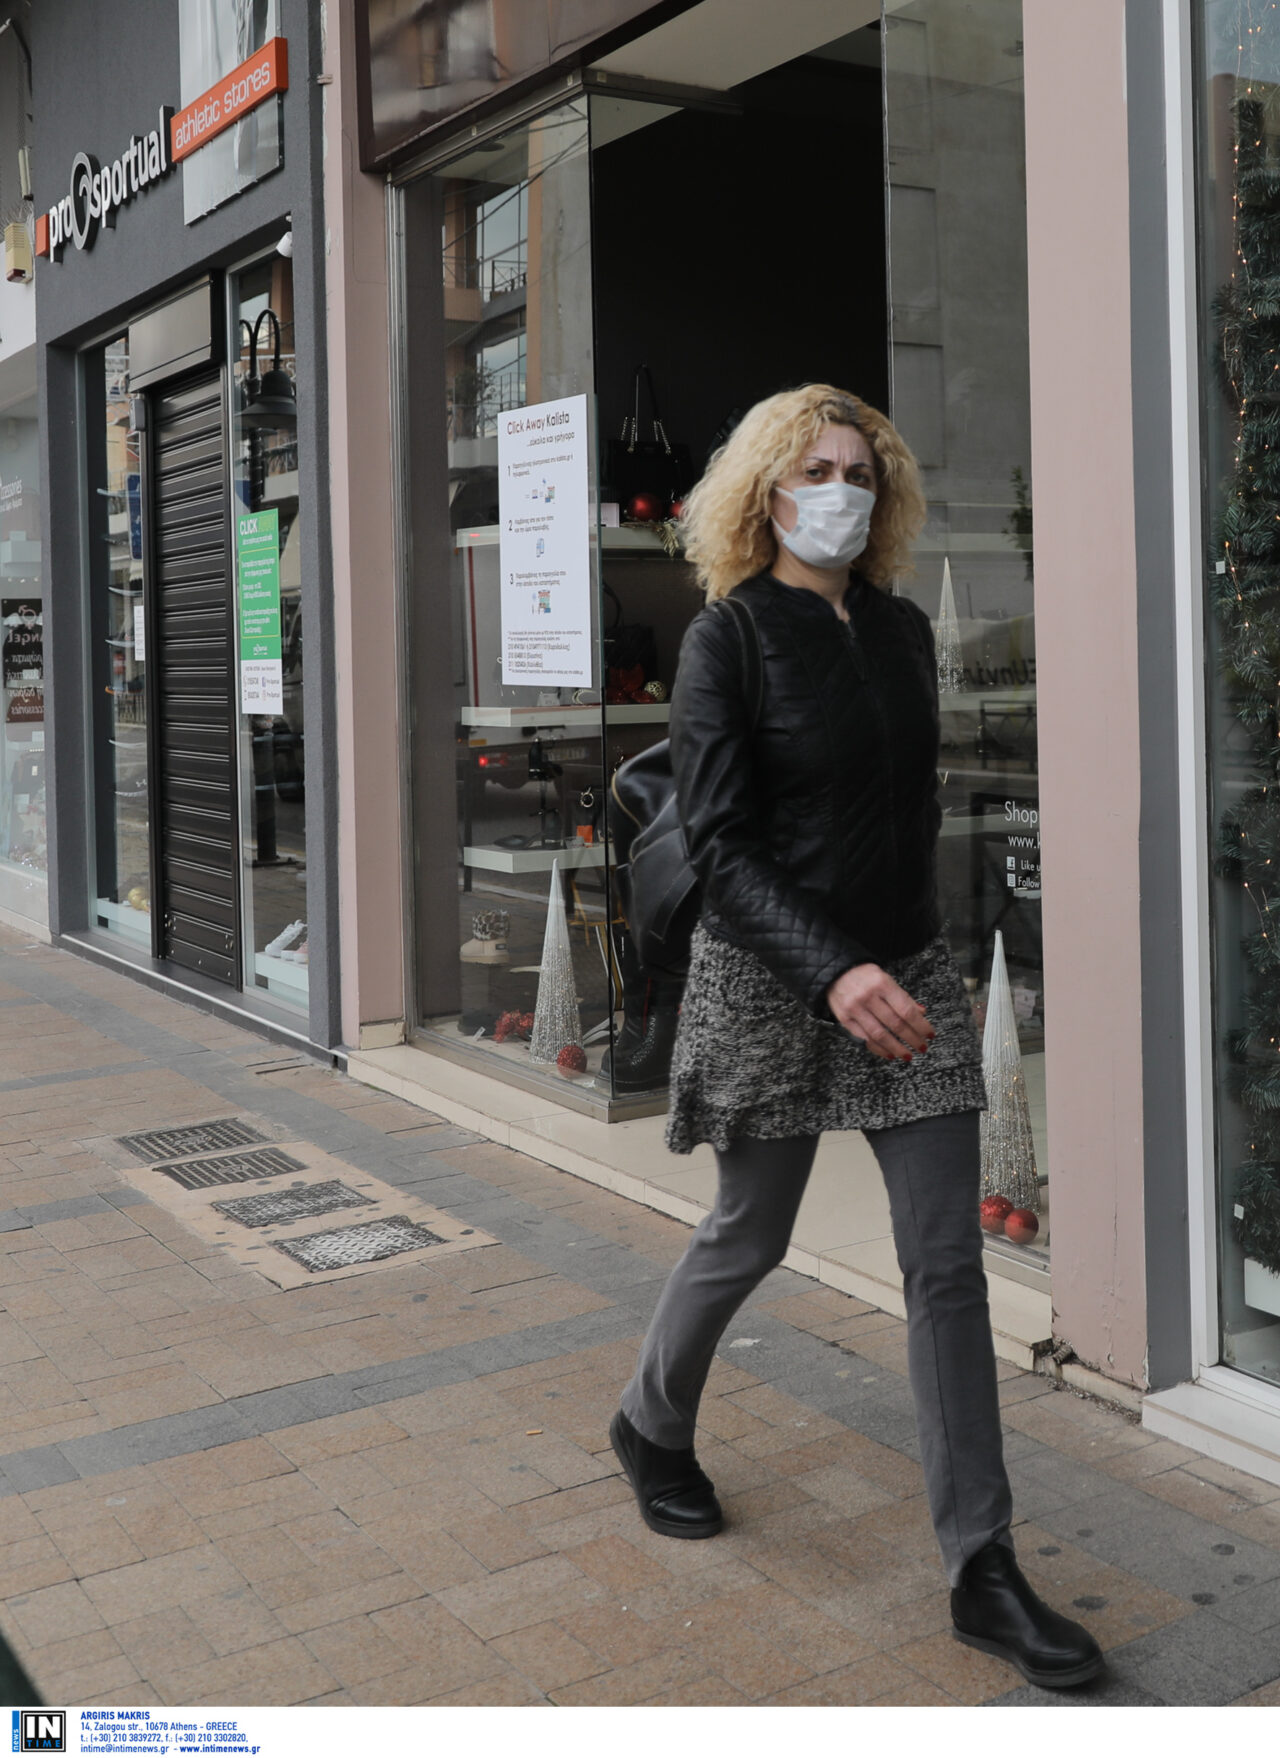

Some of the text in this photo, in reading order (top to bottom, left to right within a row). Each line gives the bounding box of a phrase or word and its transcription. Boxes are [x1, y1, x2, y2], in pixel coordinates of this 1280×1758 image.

[175, 61, 270, 150] athletic stores
[507, 411, 570, 435] Click Away Kalista
[240, 518, 258, 536] CLICK
[1004, 801, 1038, 828] Shop
[1020, 860, 1035, 871] Like
[1018, 876, 1040, 888] Follow
